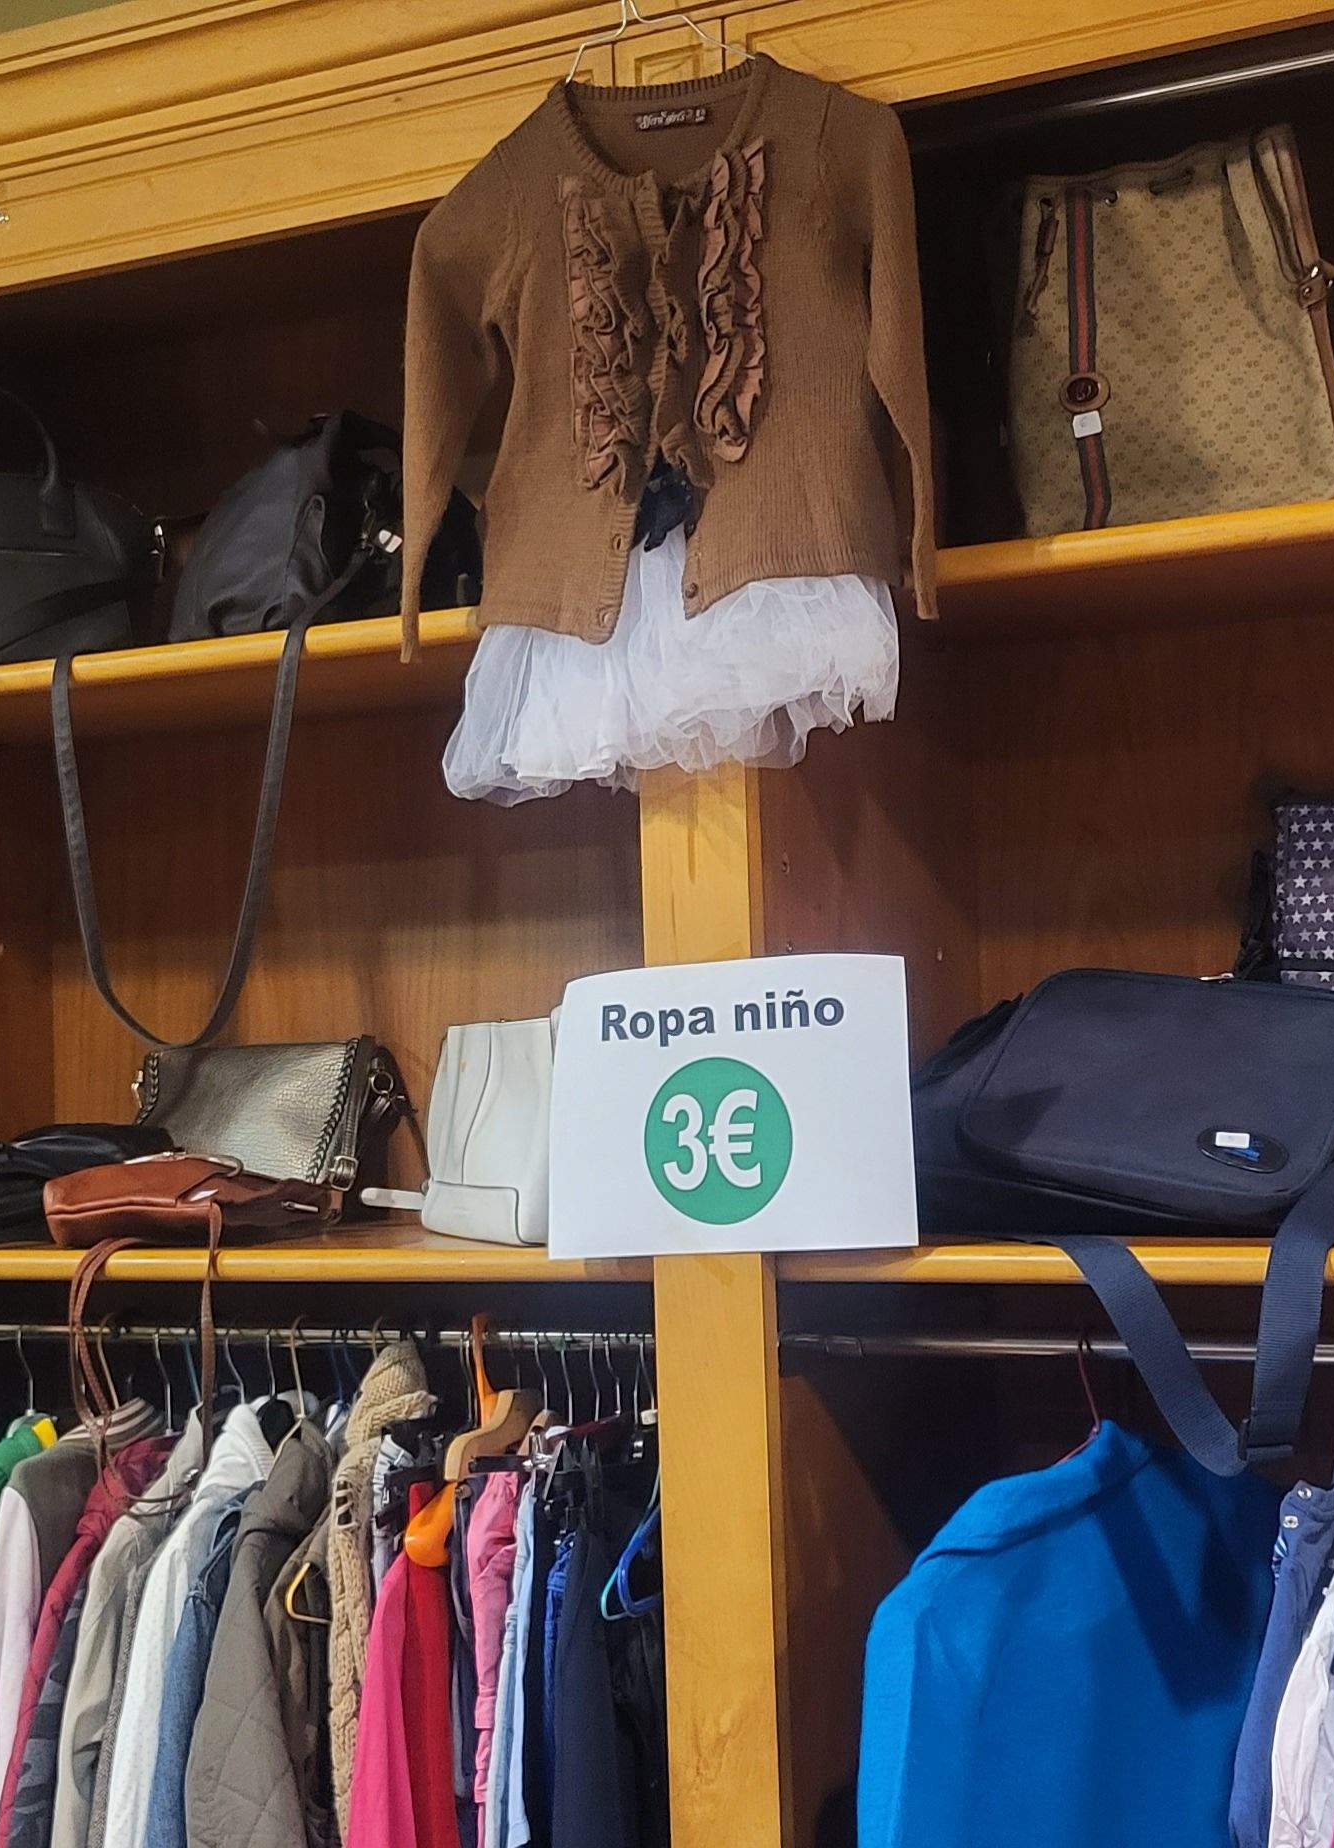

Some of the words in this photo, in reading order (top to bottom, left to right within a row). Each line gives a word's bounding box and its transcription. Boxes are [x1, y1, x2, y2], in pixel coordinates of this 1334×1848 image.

[601, 1004, 715, 1047] Ropa
[734, 989, 845, 1032] niño
[661, 1088, 762, 1192] 3€
